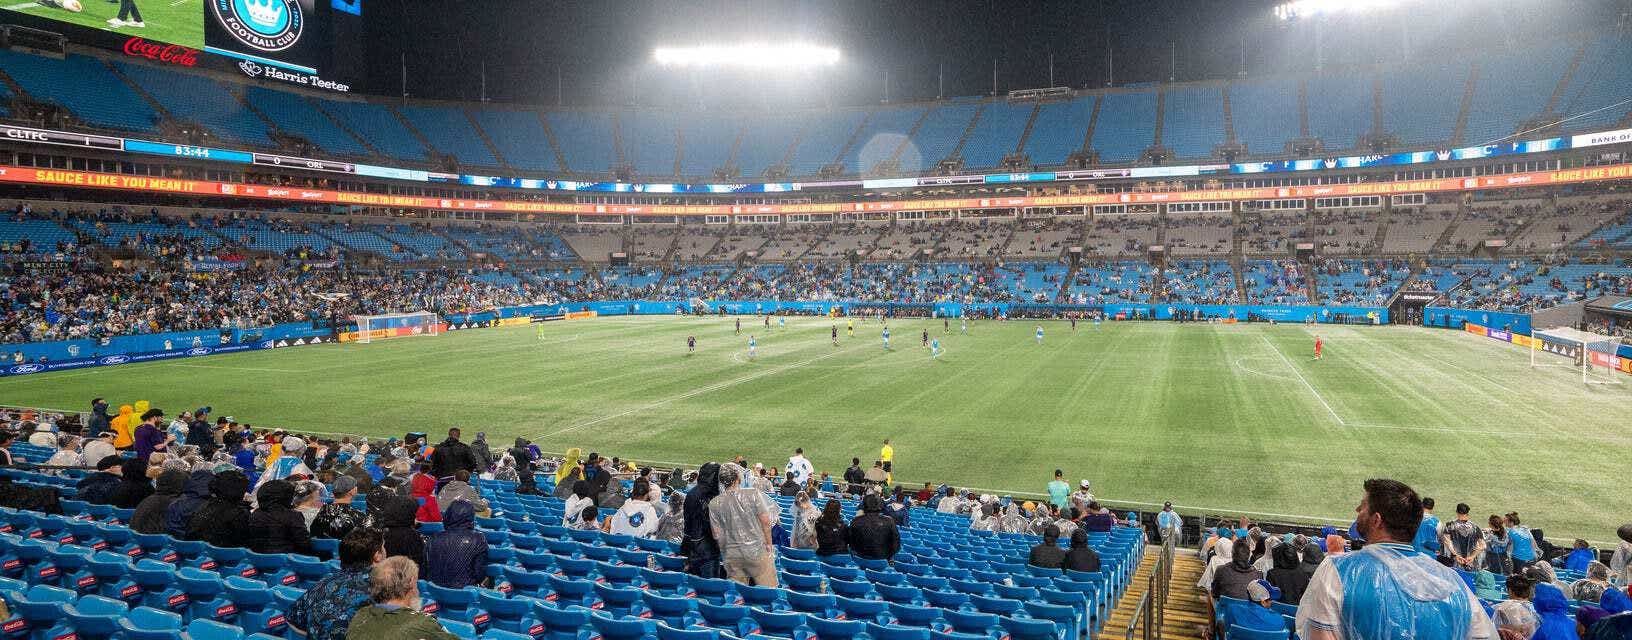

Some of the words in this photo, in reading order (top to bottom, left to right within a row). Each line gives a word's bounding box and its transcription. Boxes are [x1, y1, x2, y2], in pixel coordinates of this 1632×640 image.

[227, 17, 275, 47] FOOTBALL
[277, 31, 295, 46] CLUB
[264, 66, 308, 84] Harris
[309, 75, 349, 92] Teeter
[7, 128, 48, 141] CLTFC
[1591, 136, 1617, 144] BANK
[36, 170, 83, 182] SAUCE
[87, 174, 117, 185] LIKE
[122, 176, 146, 188] YOU
[149, 179, 182, 191] MEAN
[183, 181, 194, 191] IT
[1550, 172, 1580, 181] SAUCE
[1583, 168, 1604, 178] LIKE
[1608, 166, 1626, 177] YOU
